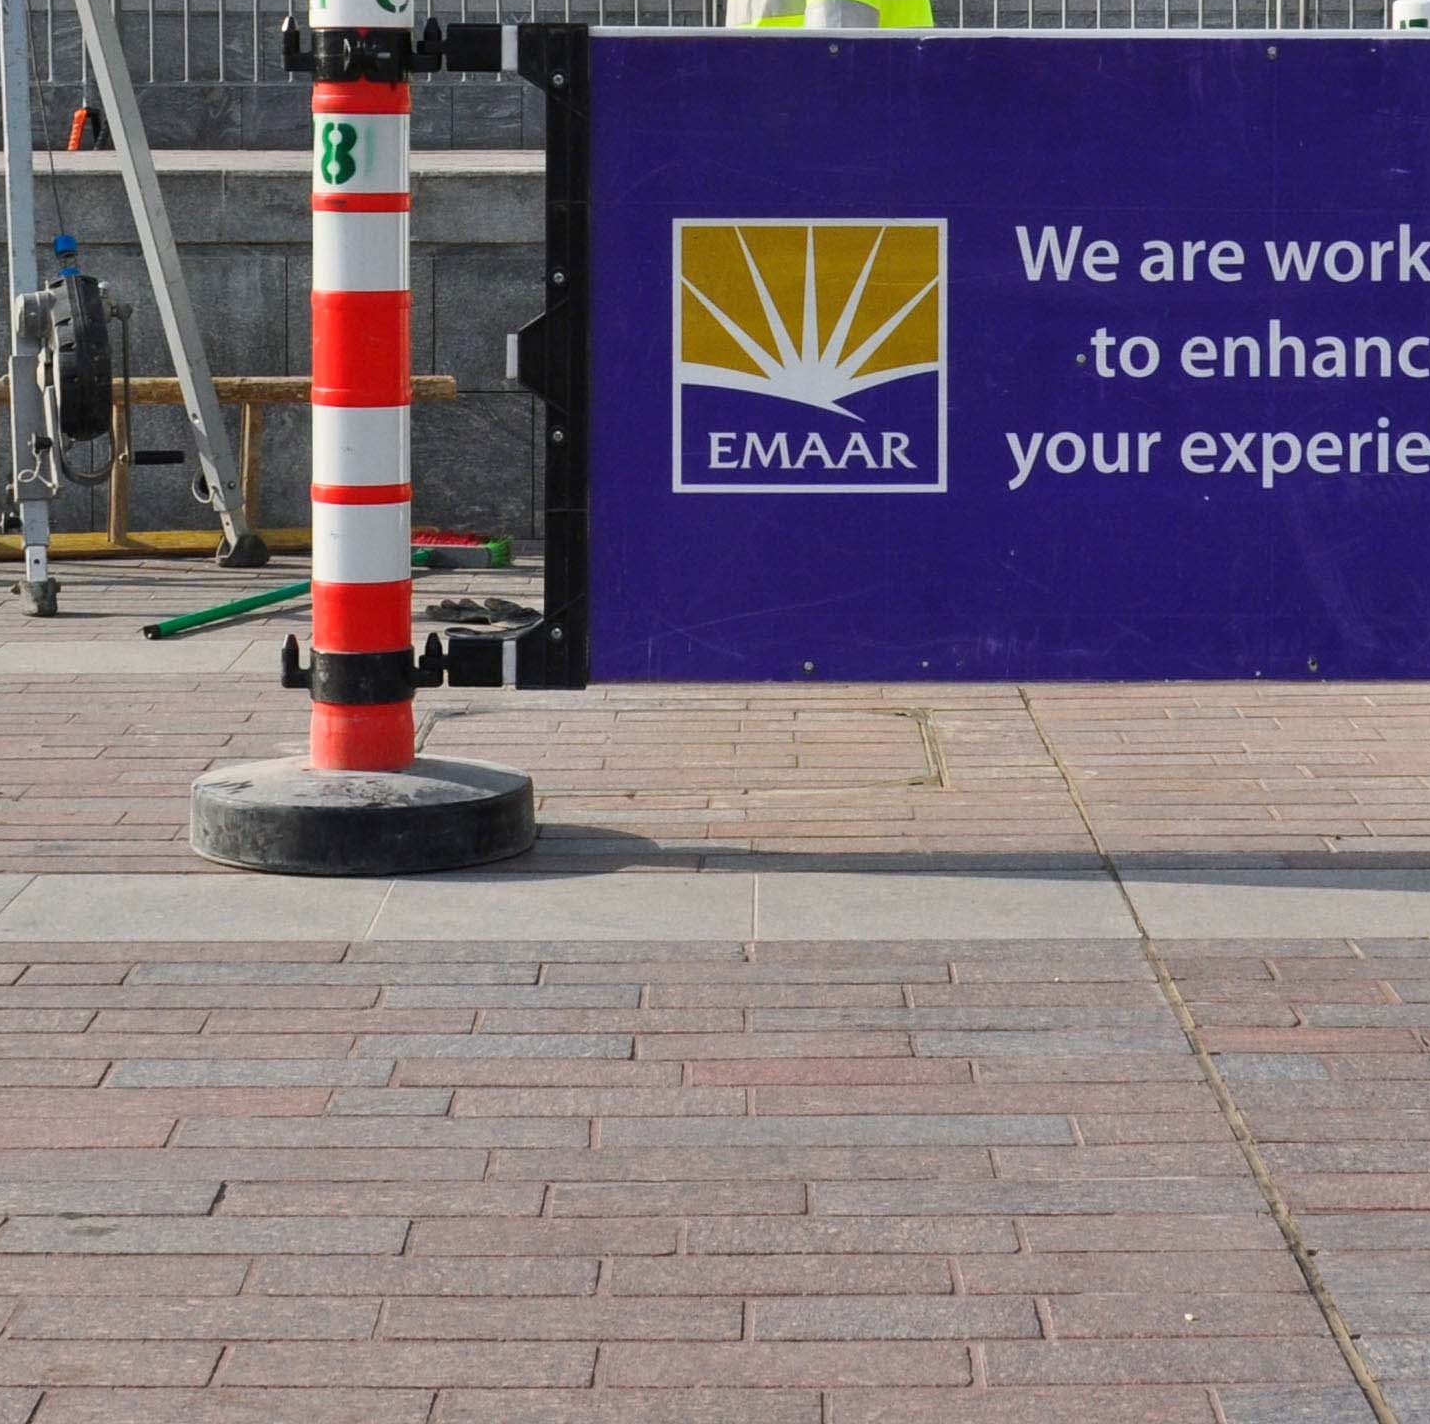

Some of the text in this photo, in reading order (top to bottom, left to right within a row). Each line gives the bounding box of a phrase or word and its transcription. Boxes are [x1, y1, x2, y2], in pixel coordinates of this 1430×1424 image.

[1015, 225, 1119, 282] We
[1140, 240, 1245, 282] are
[1090, 326, 1161, 379] to
[707, 431, 917, 471] EMAAR
[1005, 430, 1161, 490] your
